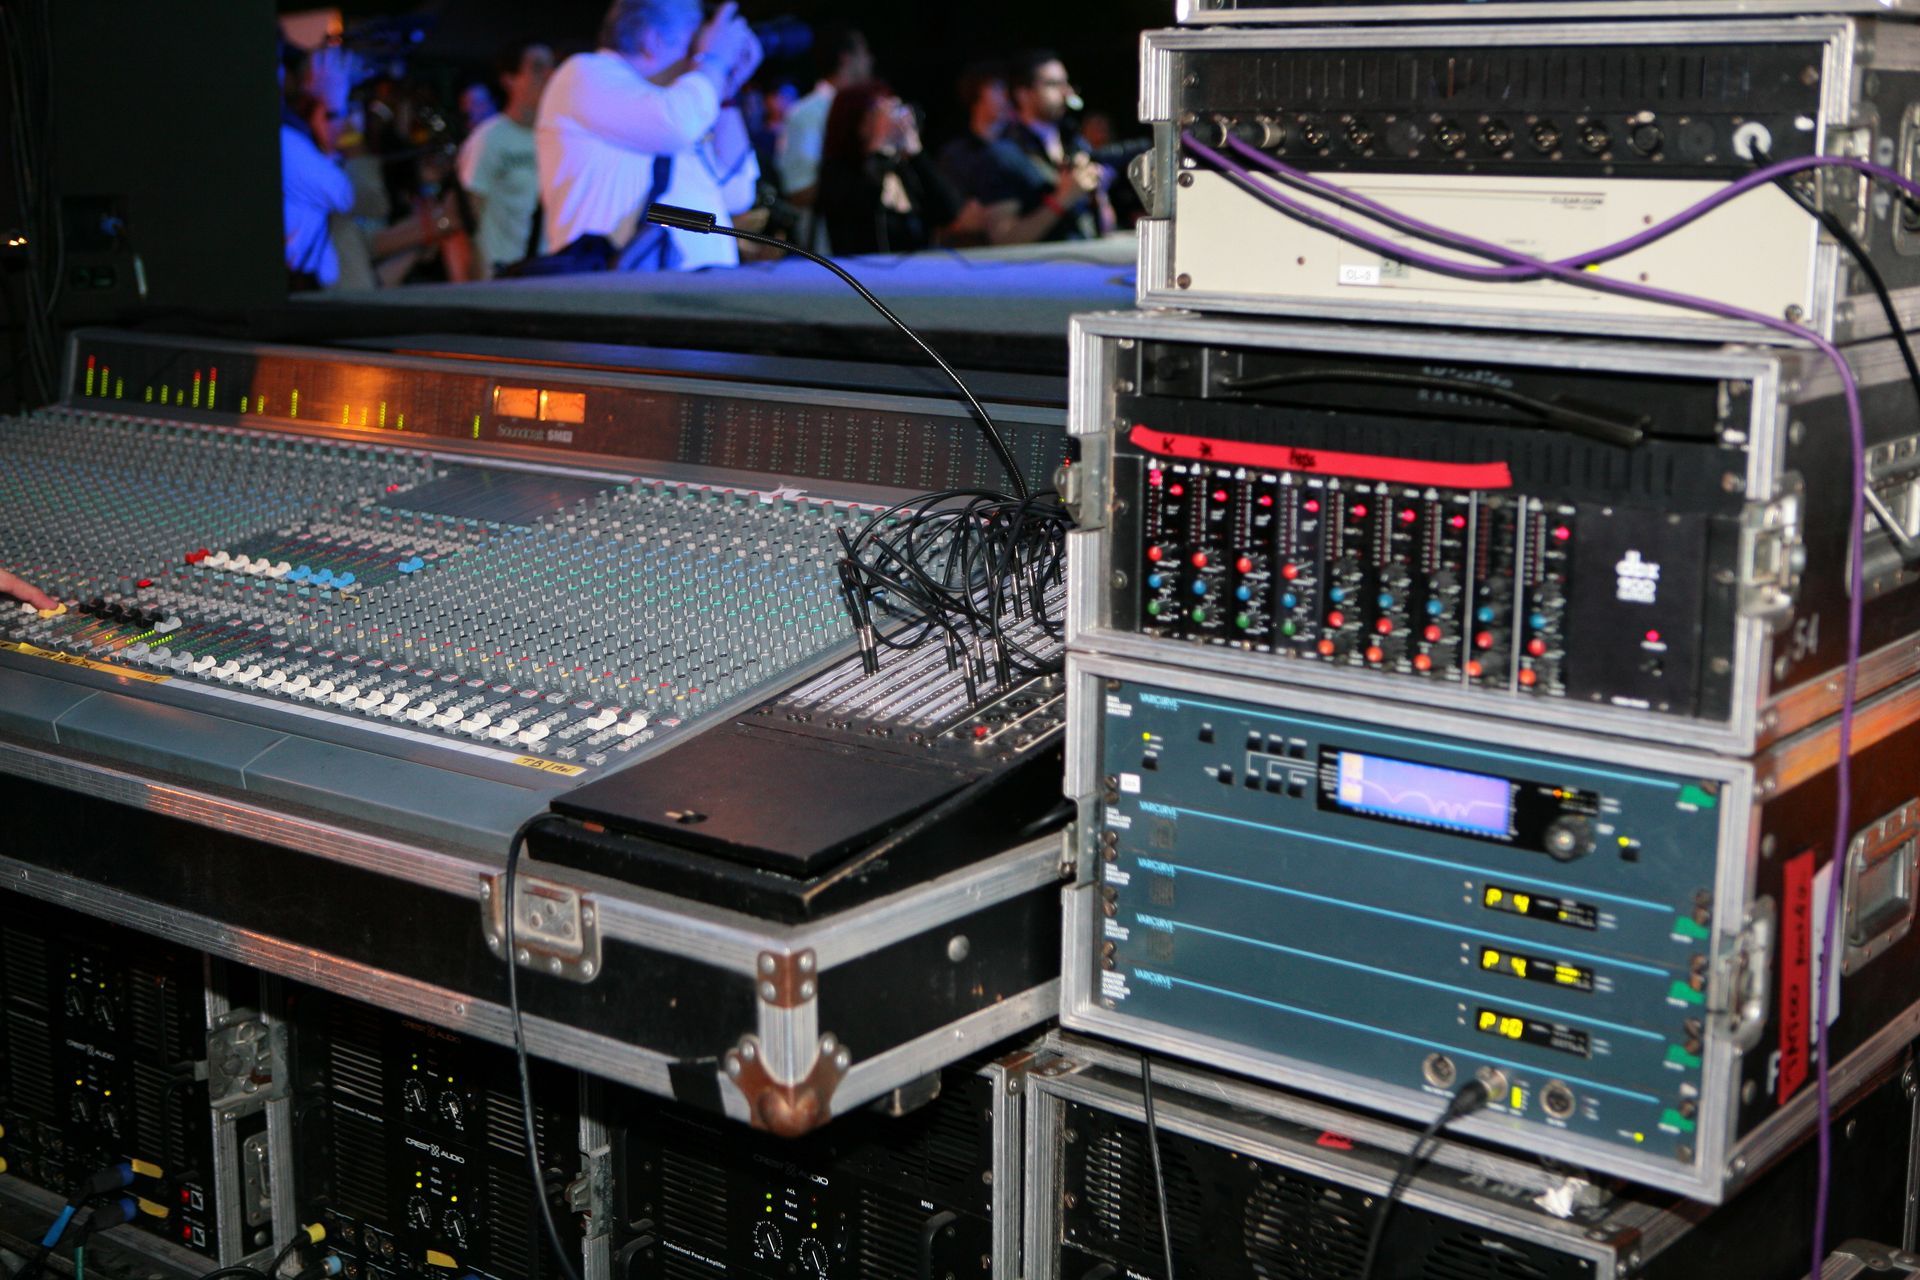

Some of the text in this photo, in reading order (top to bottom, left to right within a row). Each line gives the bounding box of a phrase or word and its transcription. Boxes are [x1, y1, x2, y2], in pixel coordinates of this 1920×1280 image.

[405, 1137, 465, 1164] CREST AUDIO
[663, 1240, 727, 1270] Professional Power Amplifier
